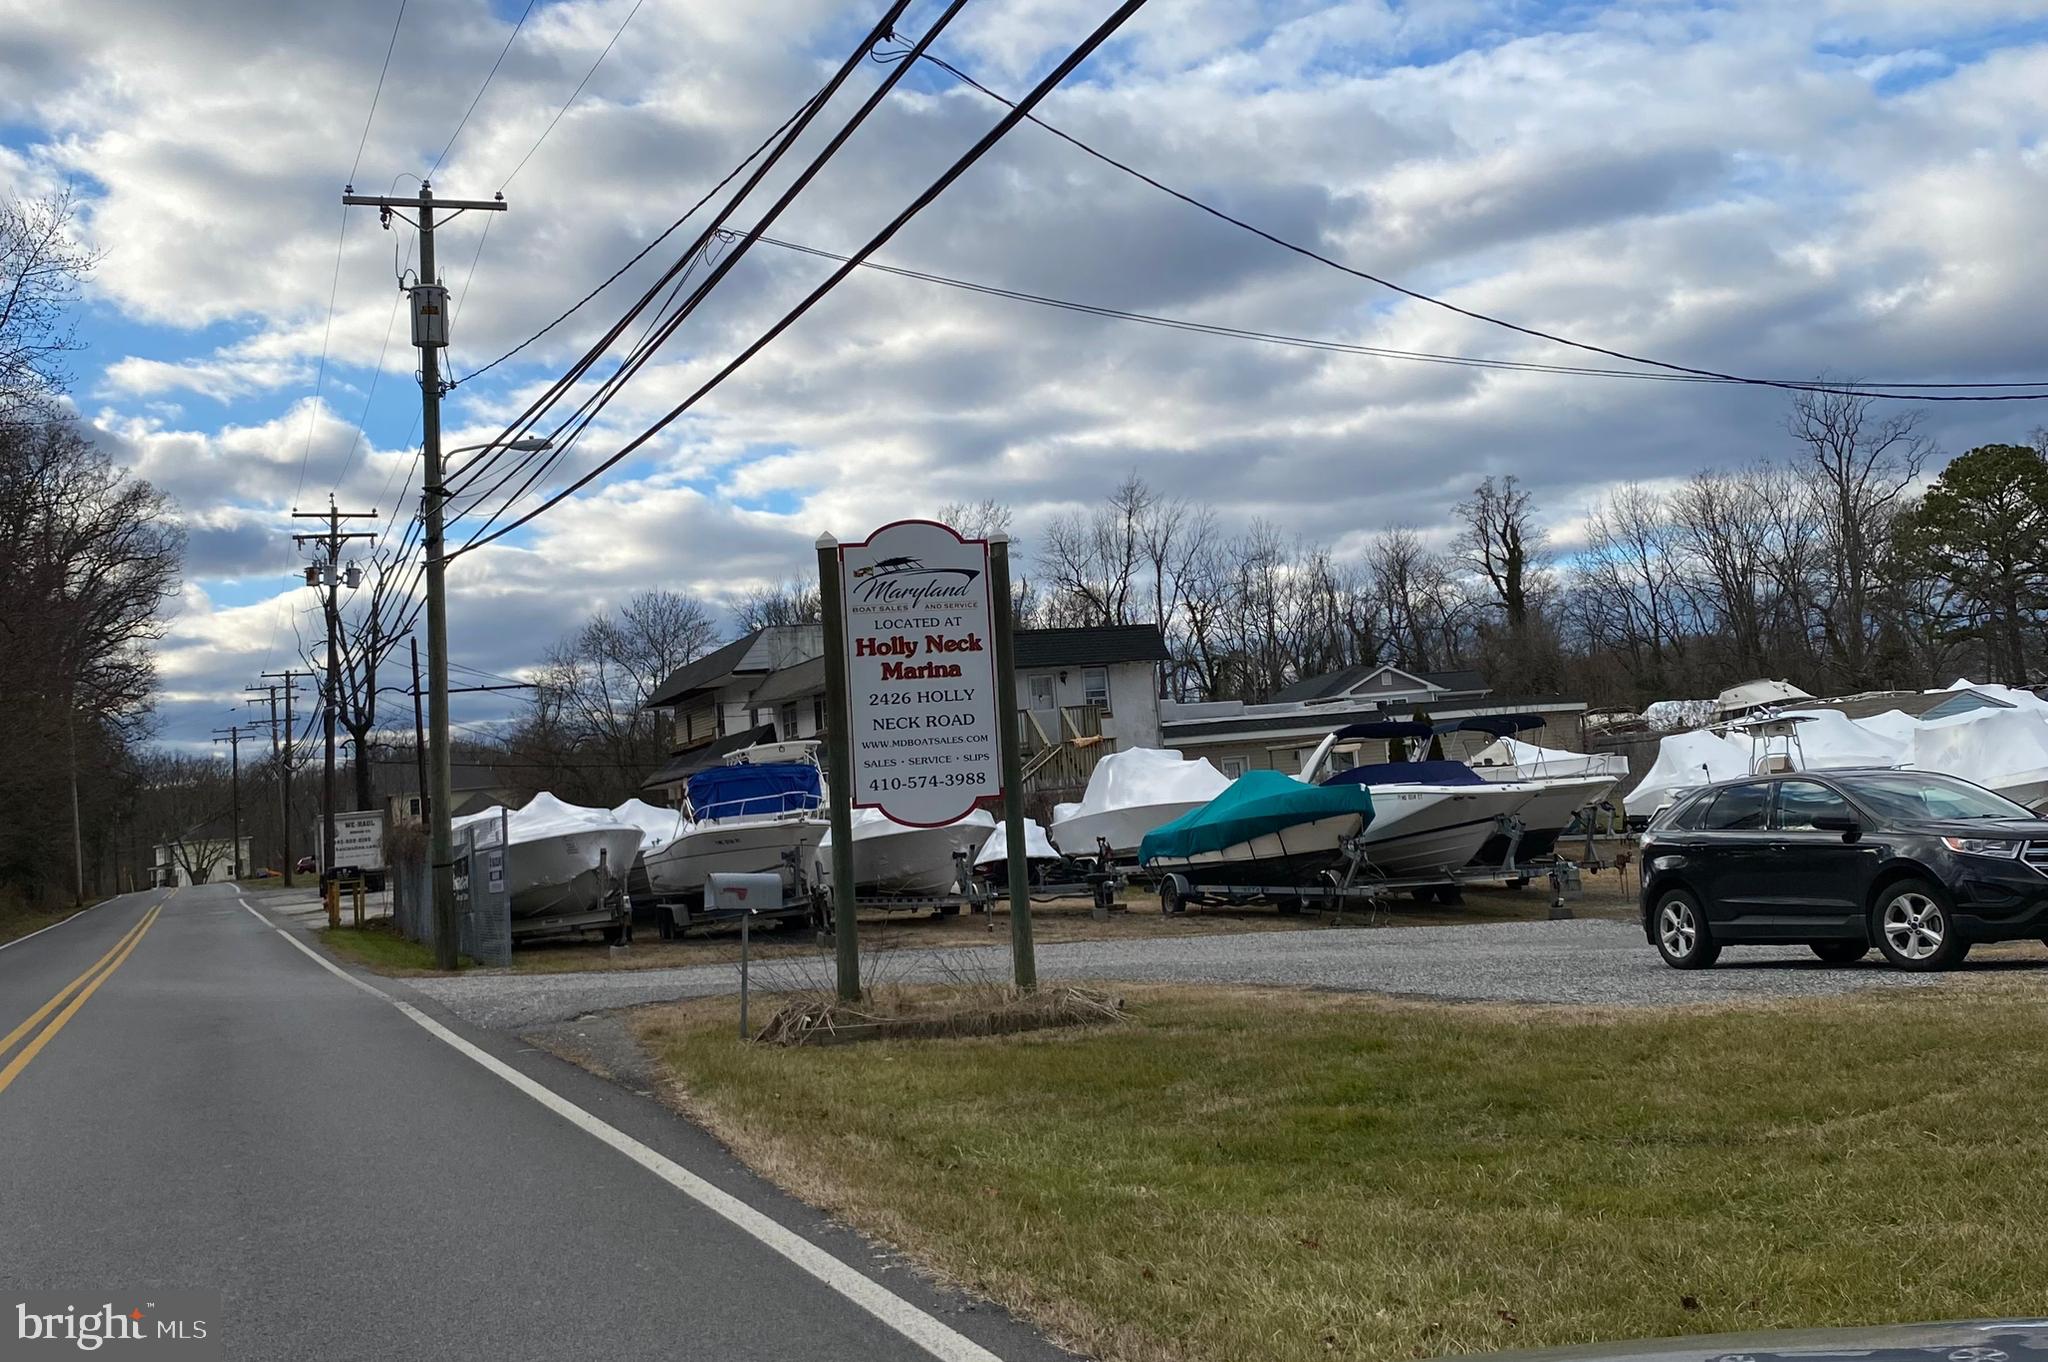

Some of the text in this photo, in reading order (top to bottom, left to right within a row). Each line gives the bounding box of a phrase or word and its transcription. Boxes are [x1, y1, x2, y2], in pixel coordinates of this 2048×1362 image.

[863, 578, 969, 609] Maryland
[879, 604, 909, 612] SALES
[944, 601, 978, 609] SERVICE
[874, 616, 962, 630] LOCATED AT
[855, 632, 983, 659] Holly Neck
[881, 661, 962, 681] Marina
[869, 688, 975, 706] 2426 HOLLY
[873, 713, 976, 731] NECK ROAD
[861, 734, 989, 750] WWW.MDBOATSALES.COM
[863, 752, 990, 769] SALES SERVICE SLIPS
[869, 772, 987, 792] 410-574-3988
